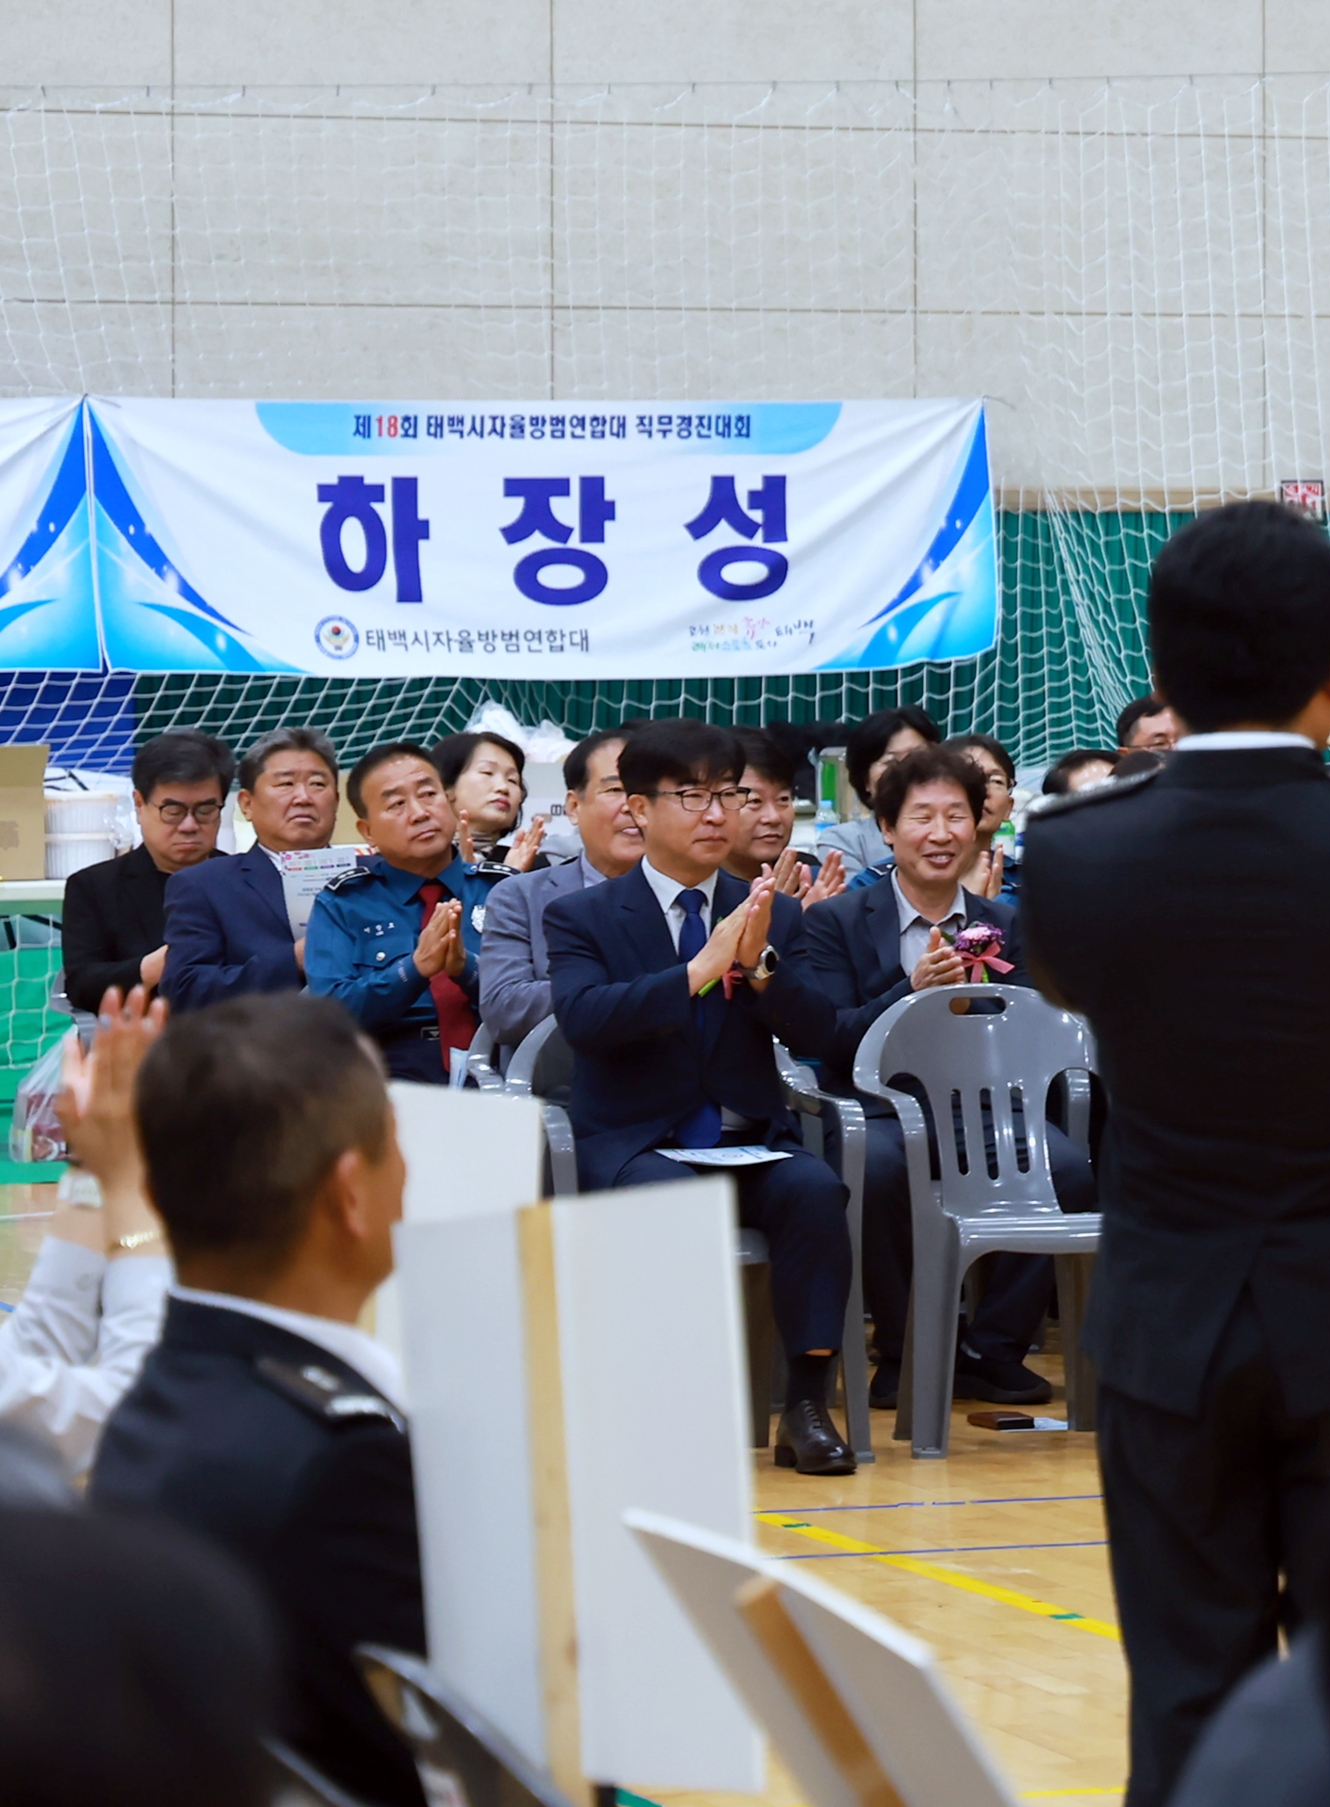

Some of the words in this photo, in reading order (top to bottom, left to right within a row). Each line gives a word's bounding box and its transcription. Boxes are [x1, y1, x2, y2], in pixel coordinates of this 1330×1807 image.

[352, 413, 418, 440] 제18회
[426, 413, 628, 440] 태백시자율방범연합대
[634, 413, 752, 440] 직무경진대회
[365, 628, 590, 653] 태백시자율방범연합대
